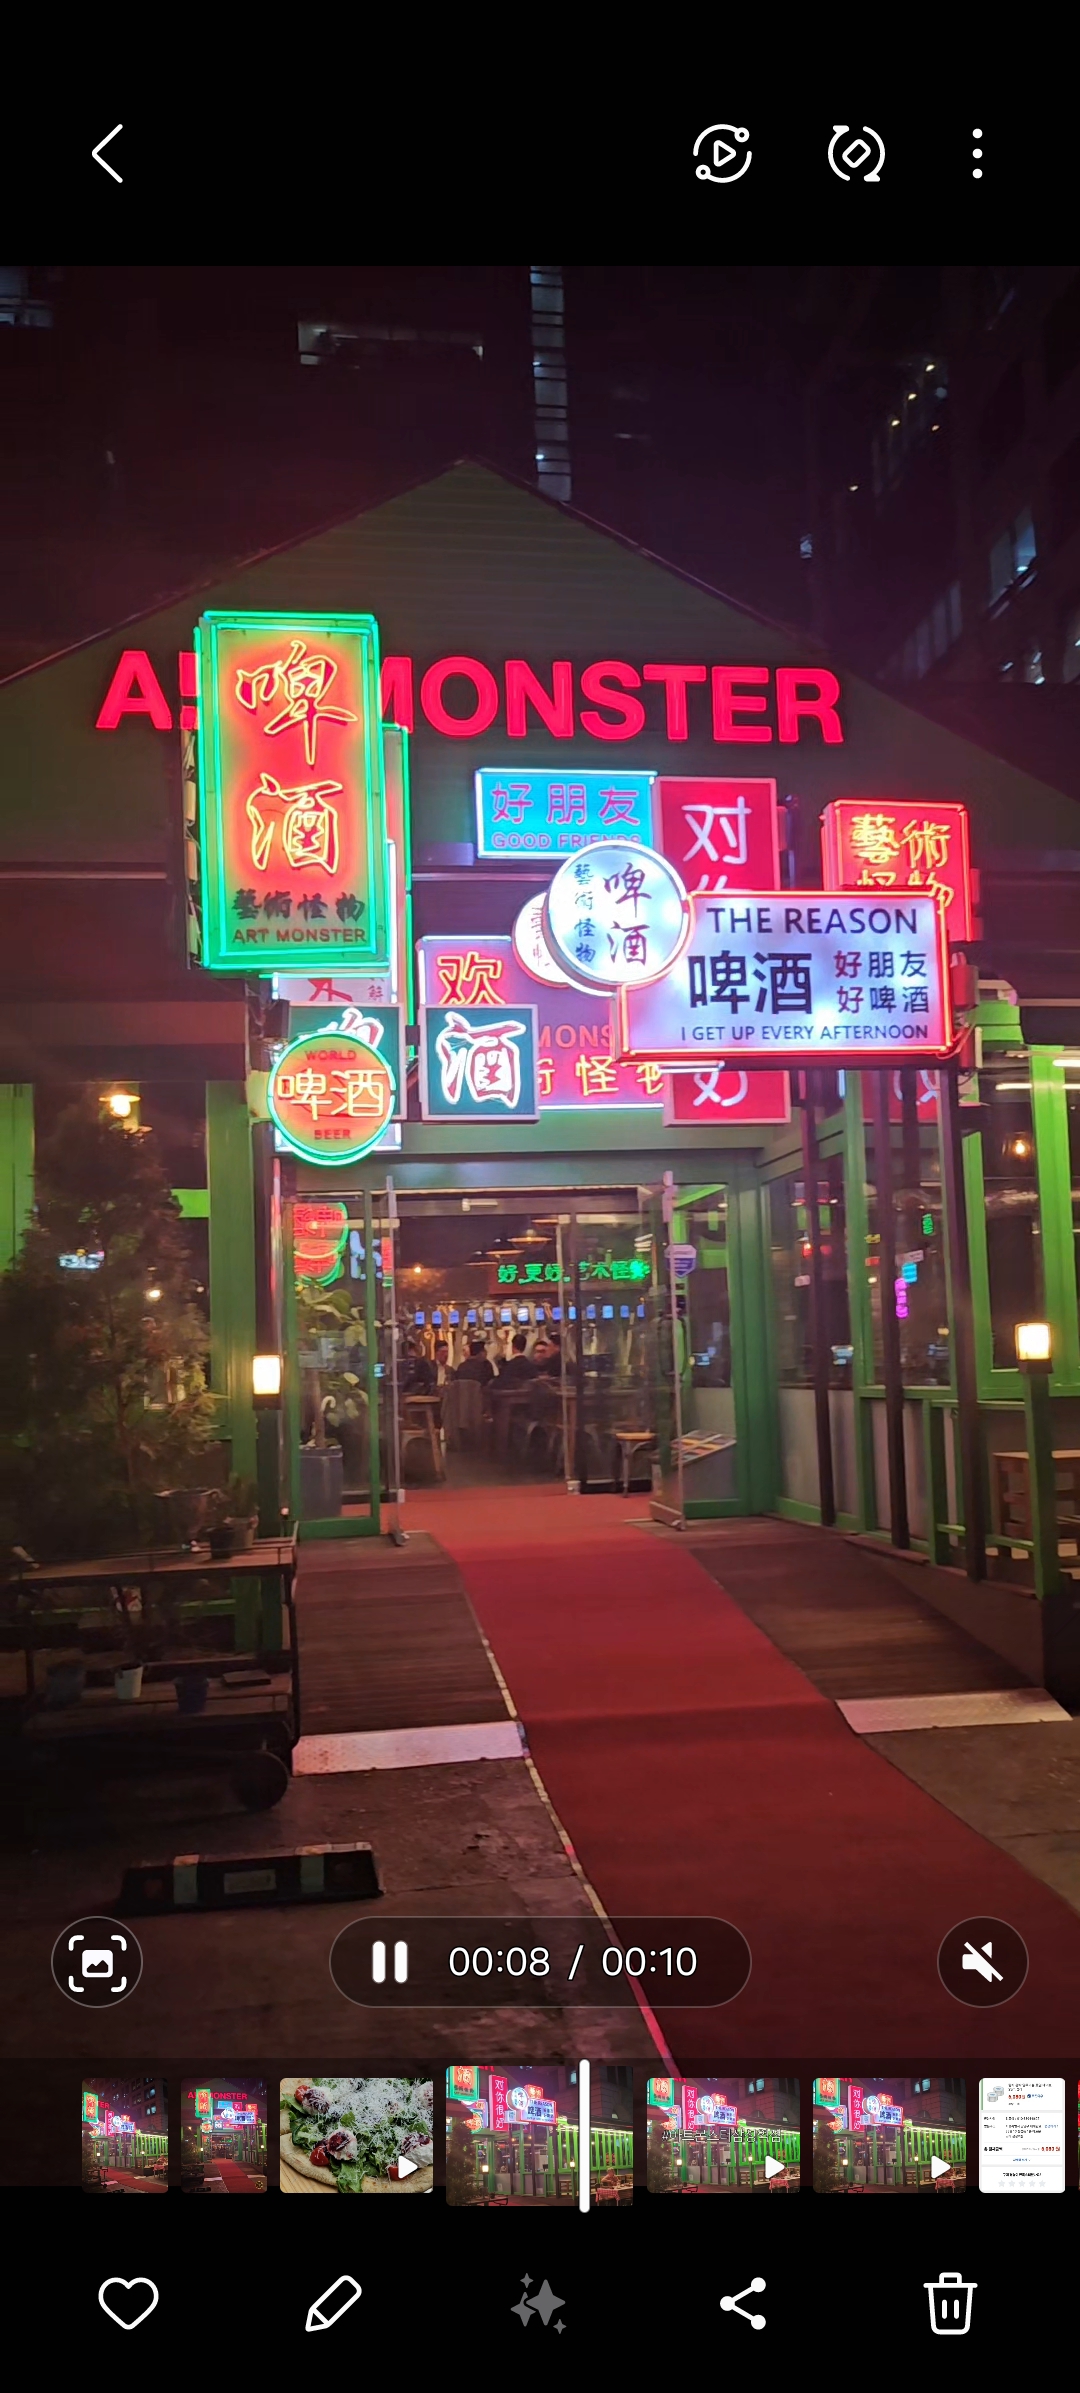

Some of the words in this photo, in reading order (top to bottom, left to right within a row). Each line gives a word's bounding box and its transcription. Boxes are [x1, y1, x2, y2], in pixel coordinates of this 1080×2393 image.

[235, 640, 359, 875] 啤酒
[491, 782, 641, 826] 好朋友
[492, 833, 551, 849] GOOD
[851, 813, 951, 868] 藝術
[603, 862, 652, 966] 啤酒
[707, 907, 772, 934] THE
[785, 907, 918, 935] REASON
[232, 928, 269, 944] ART
[276, 928, 367, 943] MONSTER
[834, 950, 927, 979] 好朋友
[687, 950, 813, 1015] 啤酒
[836, 985, 929, 1014] 好啤酒
[681, 1027, 687, 1041] I
[692, 1026, 726, 1041] GET
[732, 1026, 756, 1041] UP
[762, 1025, 815, 1040] EVERY
[820, 1024, 928, 1040] AFTERNOON
[305, 1050, 357, 1061] WORLD
[435, 1010, 527, 1109] 酒
[276, 1067, 387, 1121] 啤酒
[314, 1129, 351, 1140] BEER
